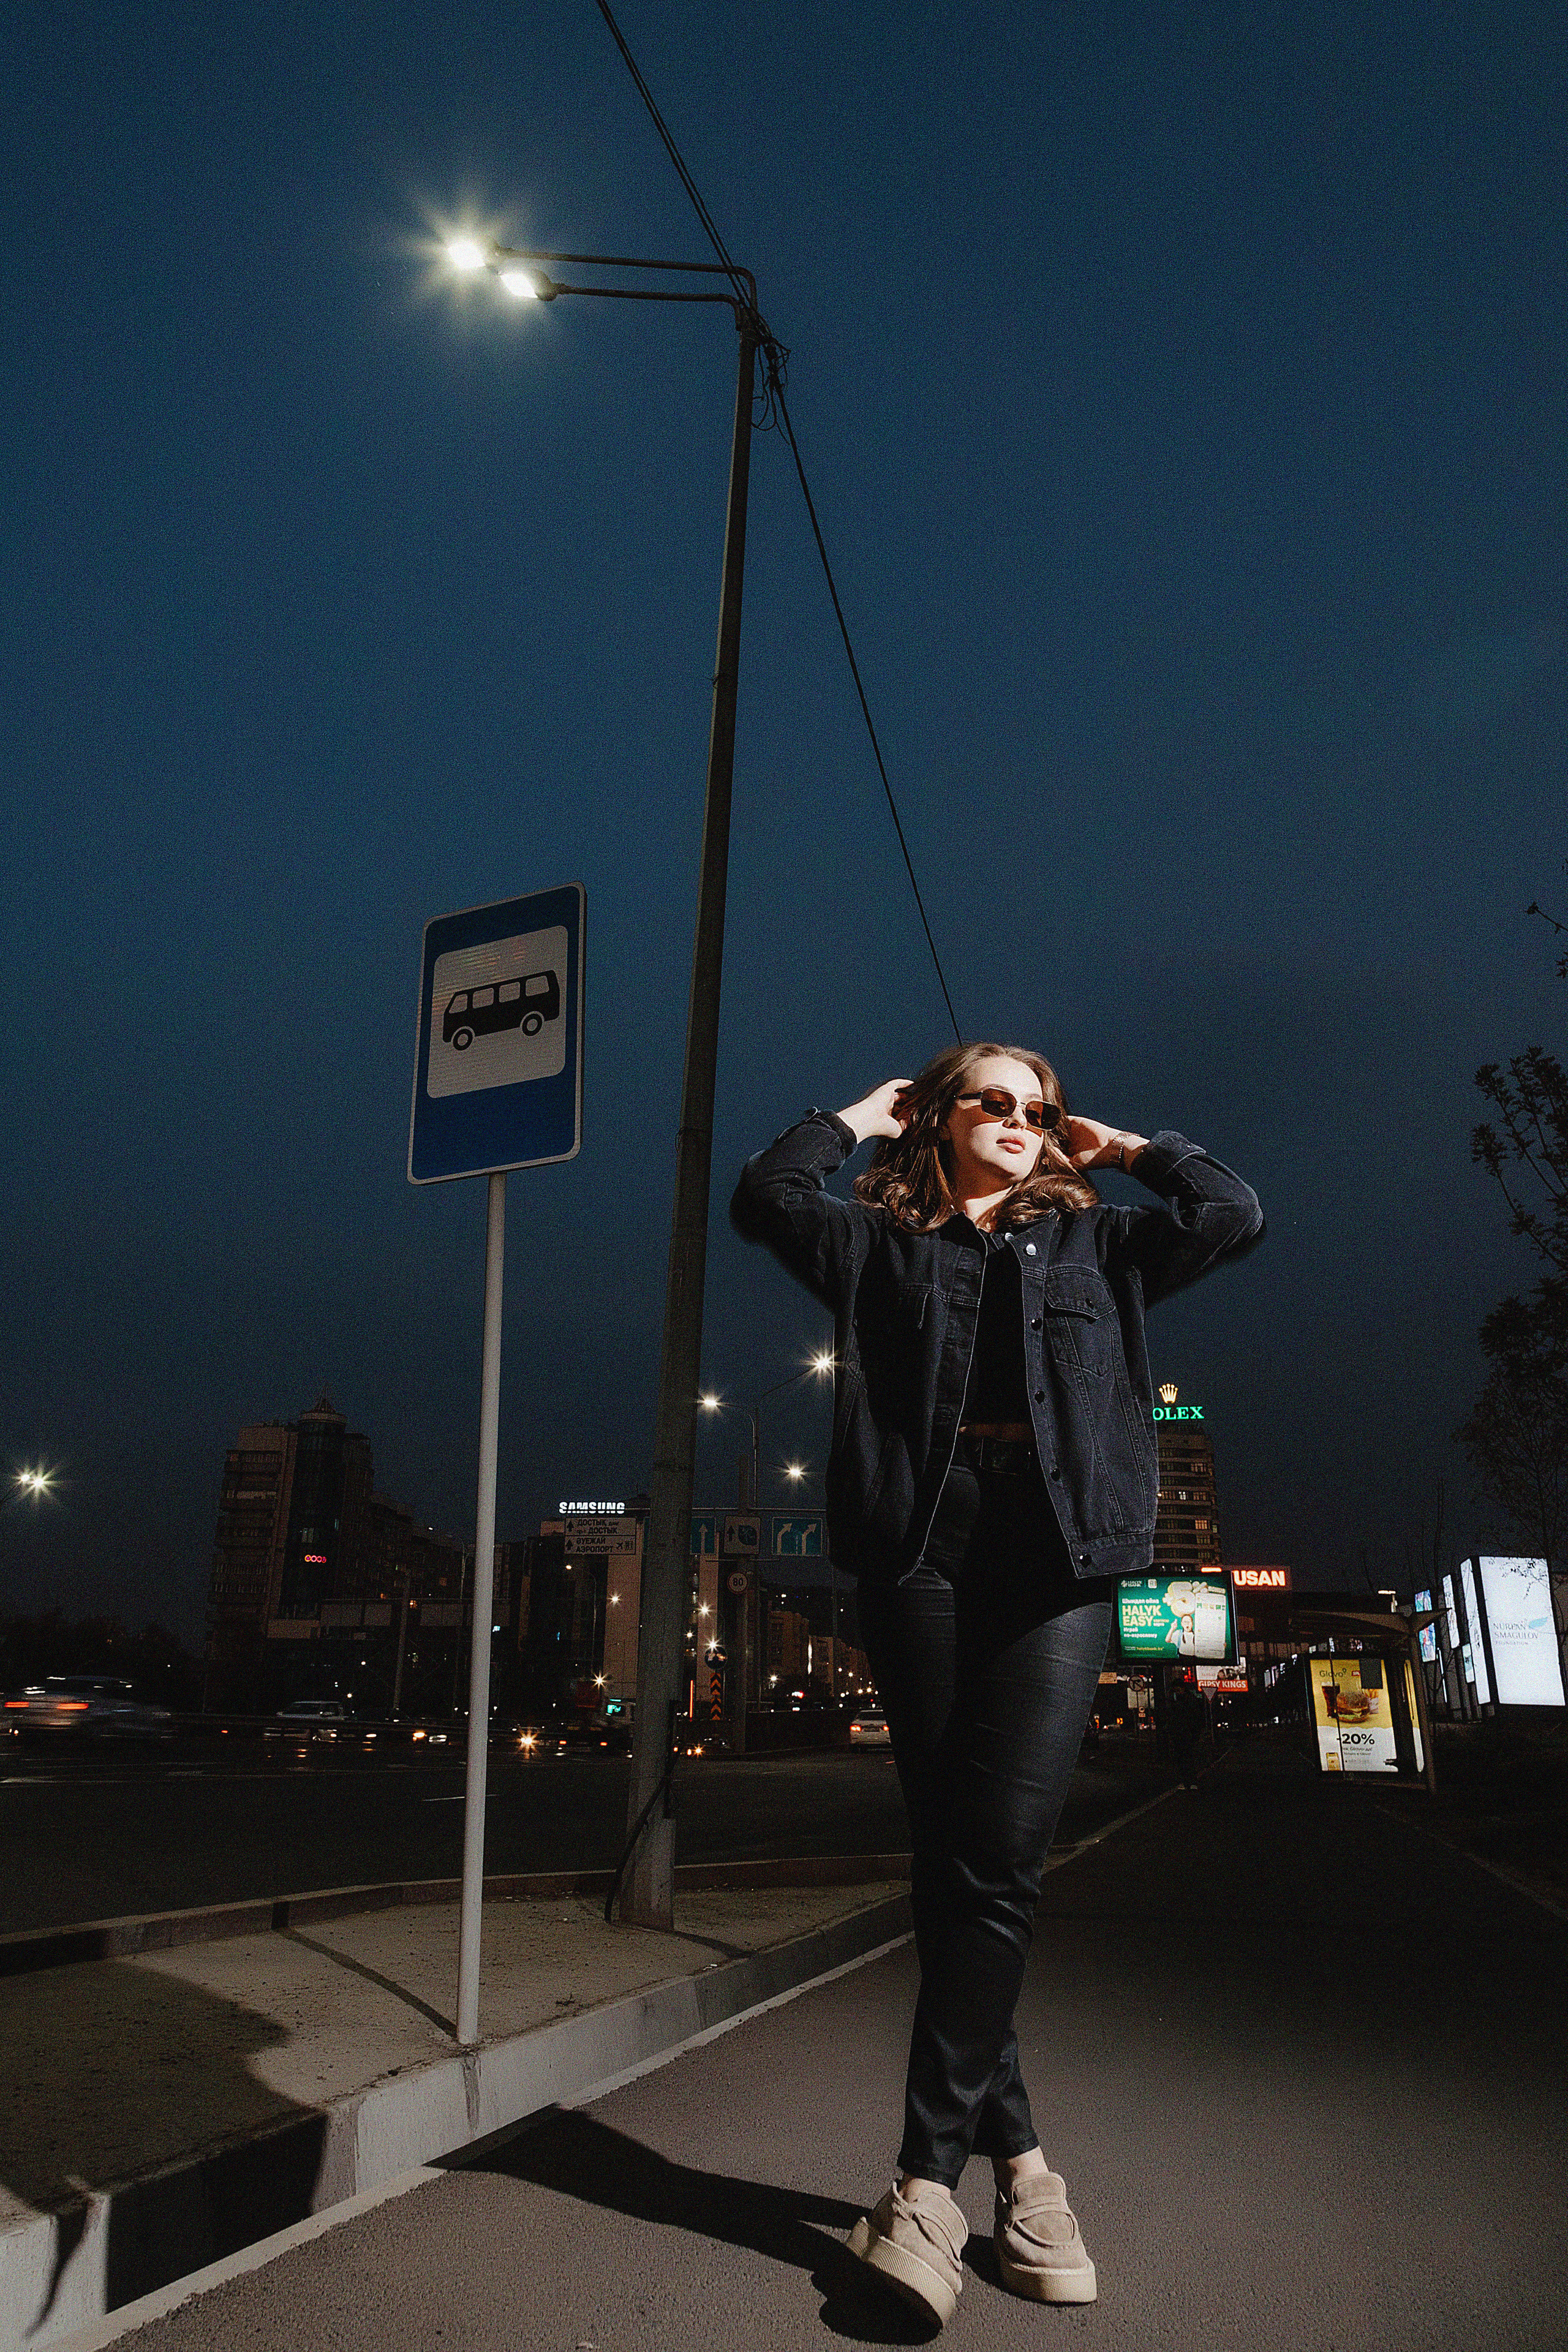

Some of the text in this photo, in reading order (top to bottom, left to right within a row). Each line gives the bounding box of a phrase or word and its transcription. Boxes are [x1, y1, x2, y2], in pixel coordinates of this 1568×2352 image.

[1153, 1406, 1204, 1420] OLEX
[559, 1502, 625, 1513] SAMSUNG
[1233, 1570, 1286, 1586] USAN
[1121, 1605, 1162, 1616] HALYK
[1123, 1615, 1153, 1626] EASY
